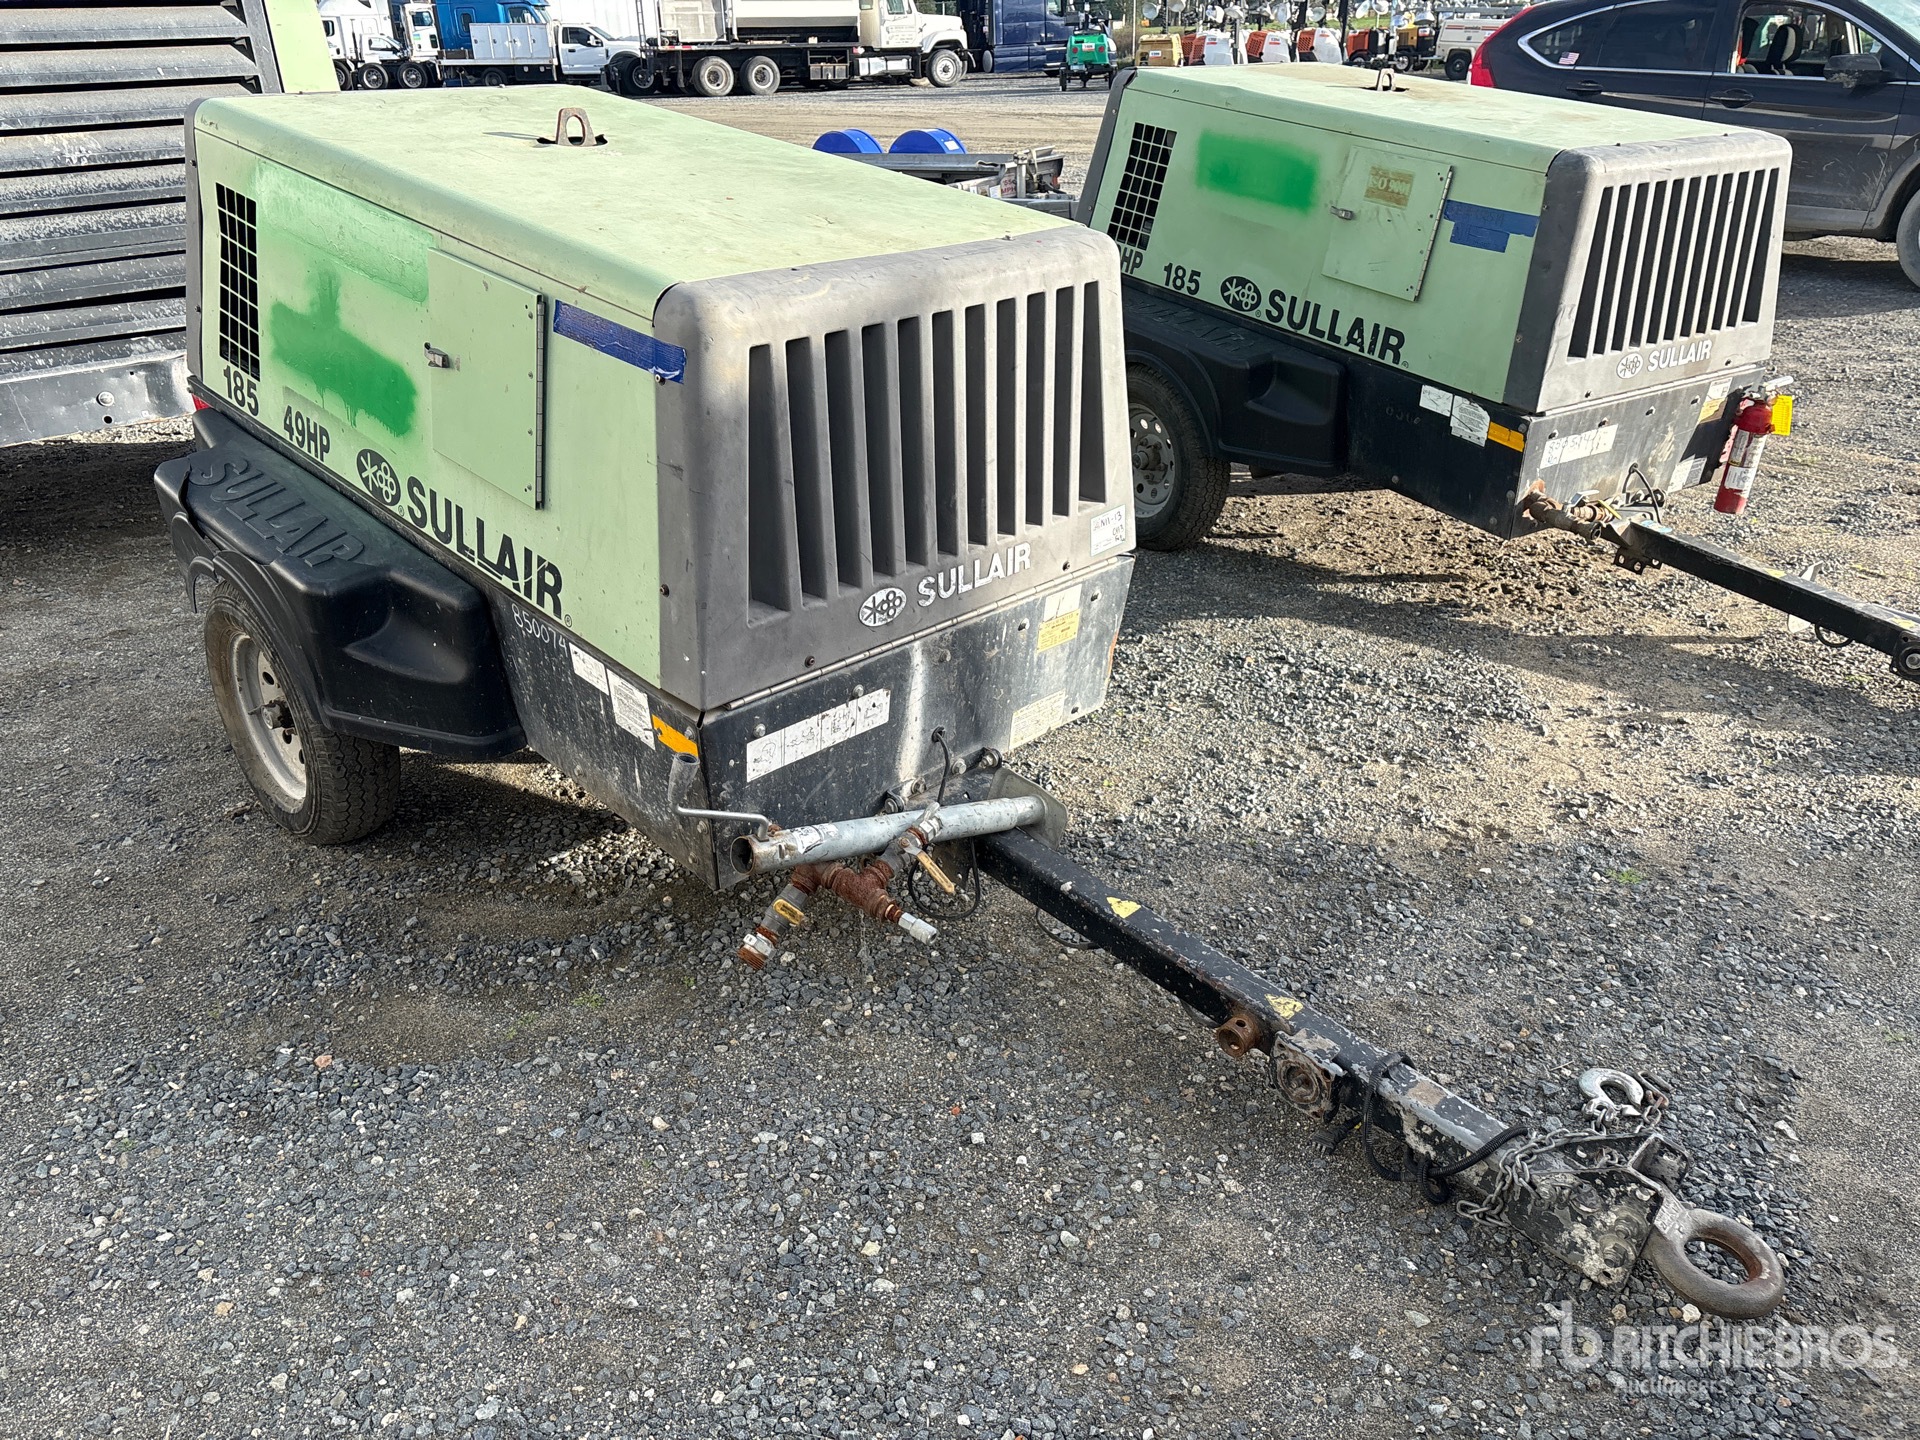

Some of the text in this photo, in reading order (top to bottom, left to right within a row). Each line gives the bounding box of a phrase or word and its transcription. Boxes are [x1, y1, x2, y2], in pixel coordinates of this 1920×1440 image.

[1163, 262, 1202, 296] 185
[1265, 288, 1406, 366] SULLAIR
[1647, 339, 1713, 372] SULLAIR
[222, 364, 260, 417] 185
[283, 405, 331, 463] 49HP
[188, 453, 366, 568] SULLAIR
[406, 475, 563, 620] SULLAIR
[917, 540, 1032, 607] SULLAIR
[511, 602, 569, 658] 850074
